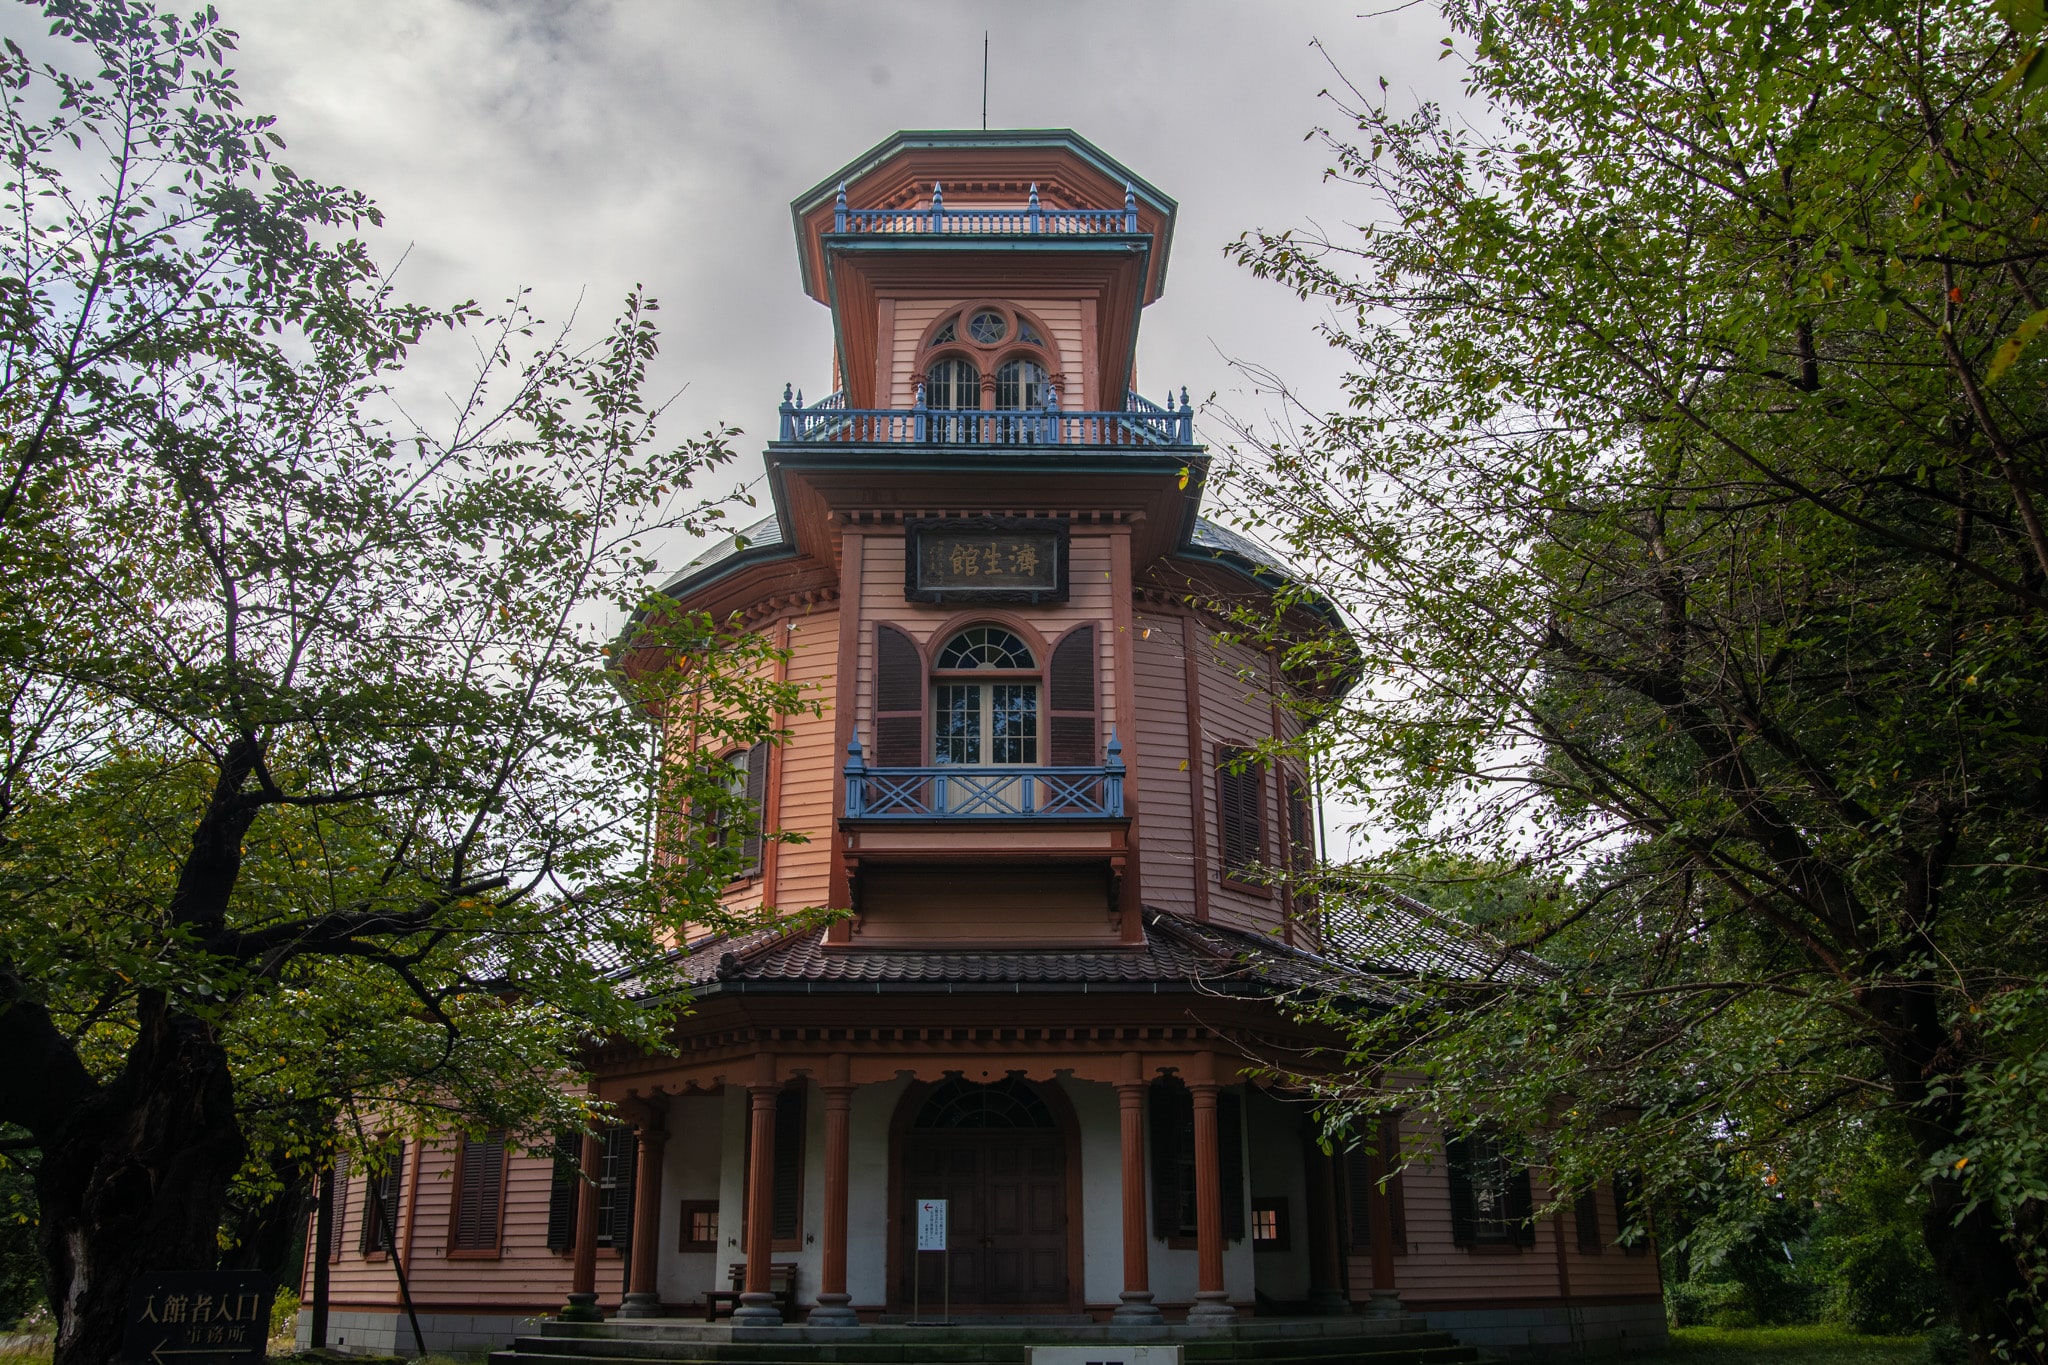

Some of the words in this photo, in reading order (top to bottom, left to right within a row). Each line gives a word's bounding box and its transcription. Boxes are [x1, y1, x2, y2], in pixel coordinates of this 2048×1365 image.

[137, 1293, 260, 1325] 入館者入口
[186, 1325, 246, 1344] 事務所
